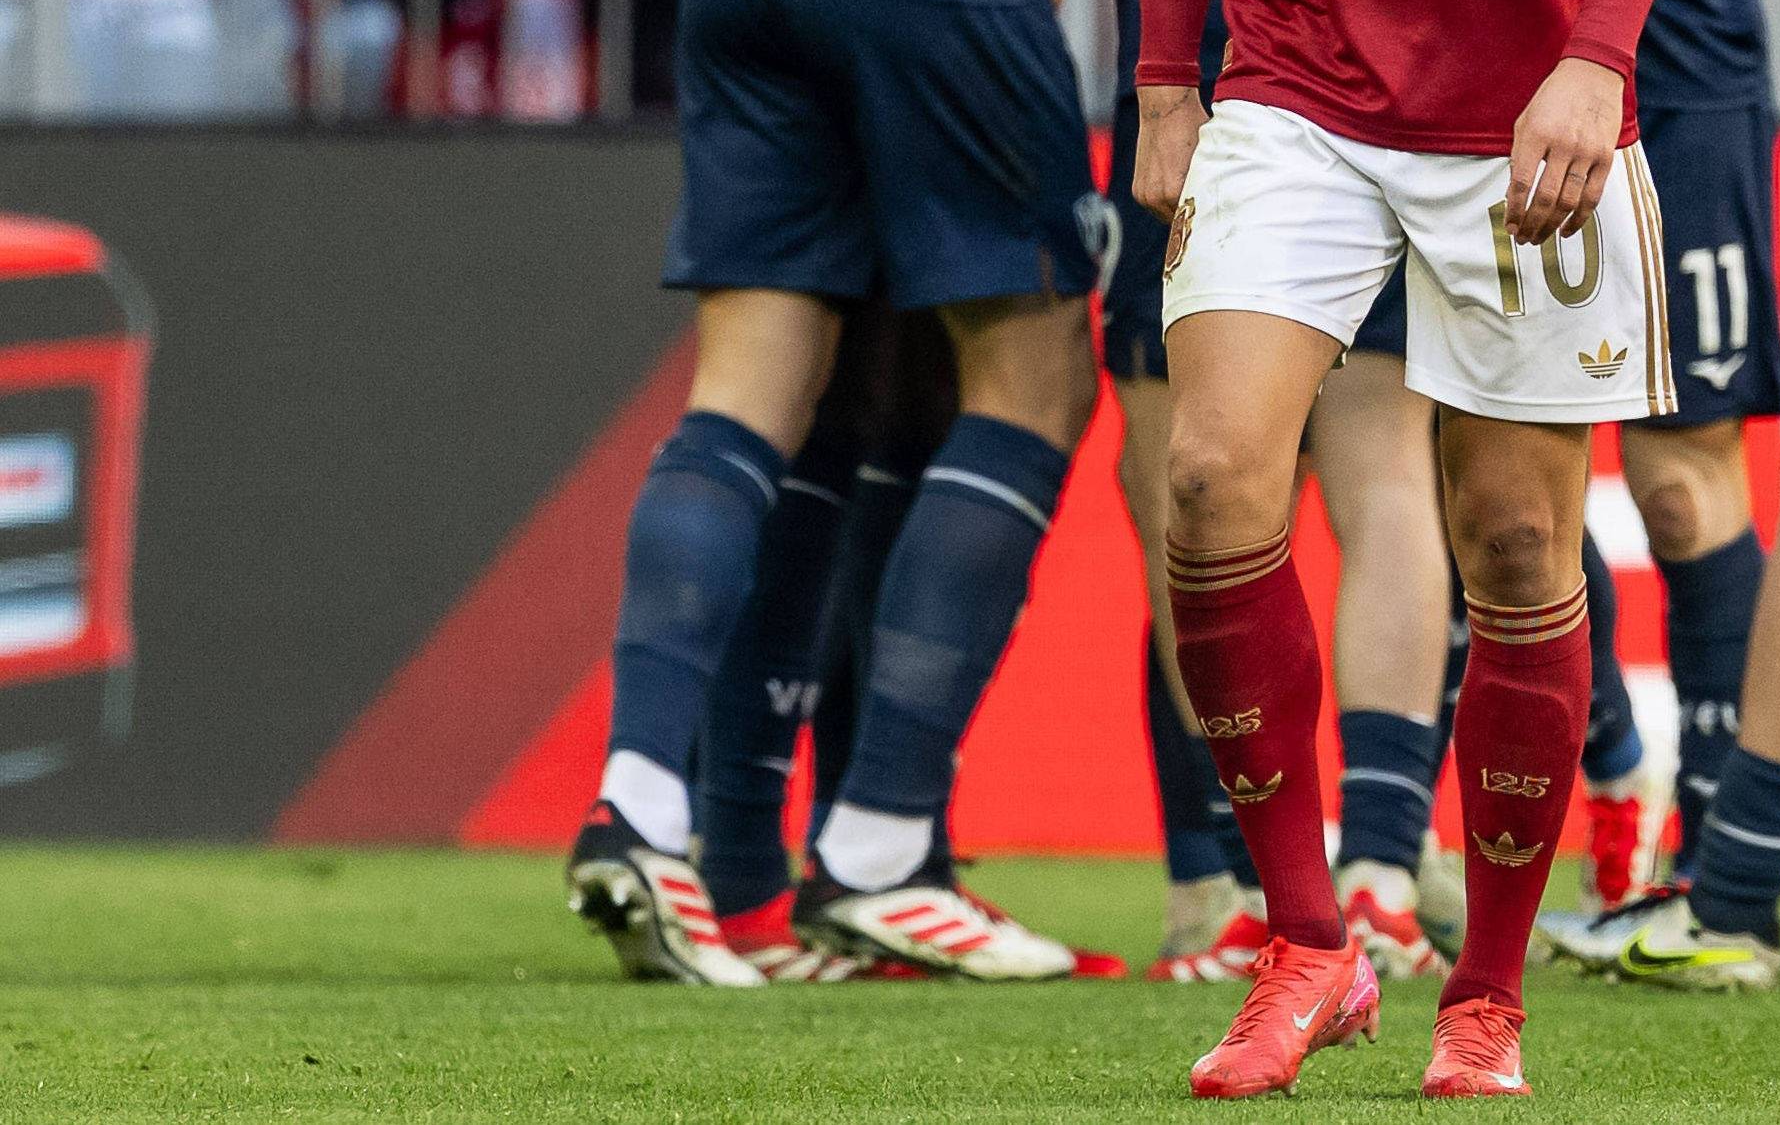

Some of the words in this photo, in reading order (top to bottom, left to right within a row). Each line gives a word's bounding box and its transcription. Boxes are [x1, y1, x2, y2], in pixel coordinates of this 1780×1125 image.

[1488, 199, 1604, 317] 10
[1679, 242, 1749, 356] 11
[1480, 767, 1551, 799] 125
